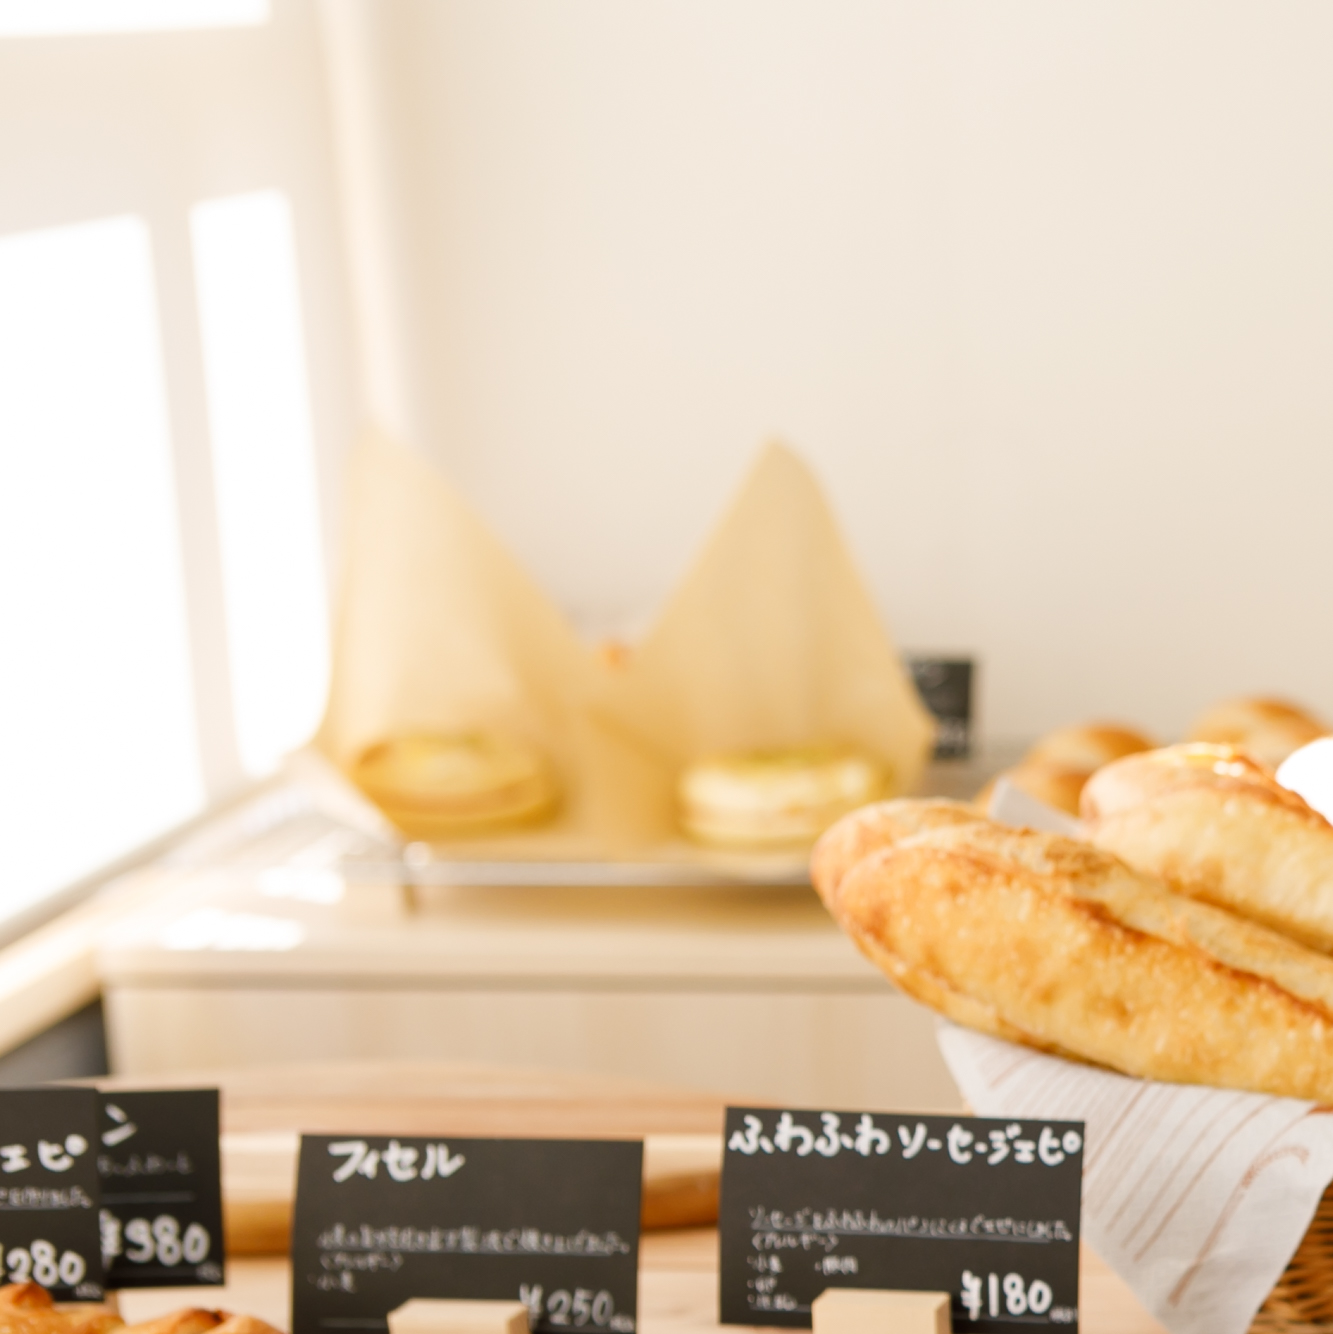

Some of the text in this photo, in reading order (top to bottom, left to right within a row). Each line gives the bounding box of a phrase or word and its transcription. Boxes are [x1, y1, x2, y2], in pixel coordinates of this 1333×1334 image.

[328, 1139, 465, 1183] フィセル
[0, 1239, 86, 1287] 280
[519, 1283, 615, 1327] ¥250
[961, 1270, 1053, 1321] ¥180
